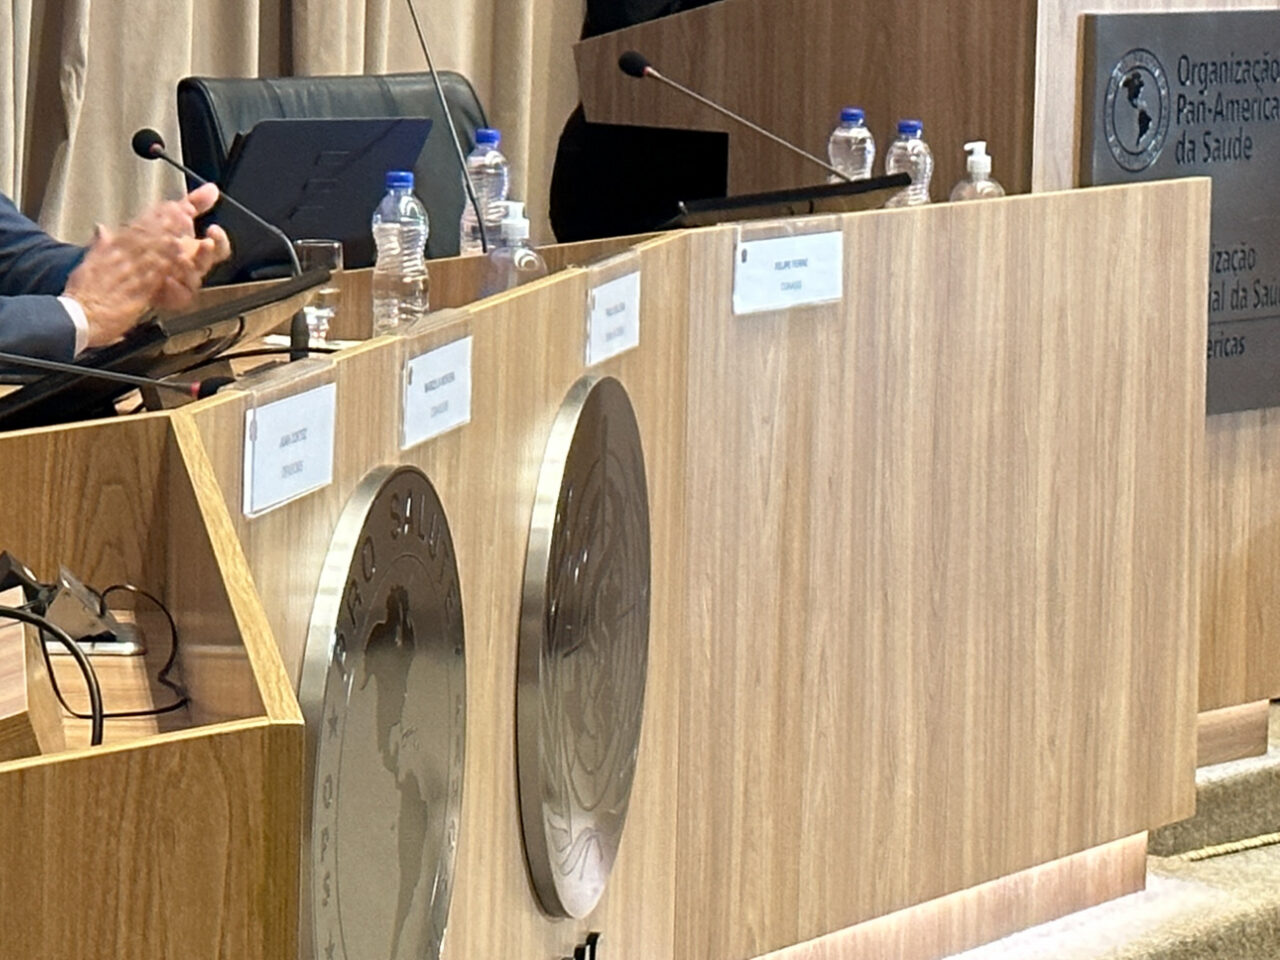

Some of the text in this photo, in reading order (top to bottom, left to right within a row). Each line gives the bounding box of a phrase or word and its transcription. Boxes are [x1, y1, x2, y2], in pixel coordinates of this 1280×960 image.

[1175, 129, 1196, 165] da
[1230, 279, 1248, 311] da
[1252, 277, 1280, 309] Saú
